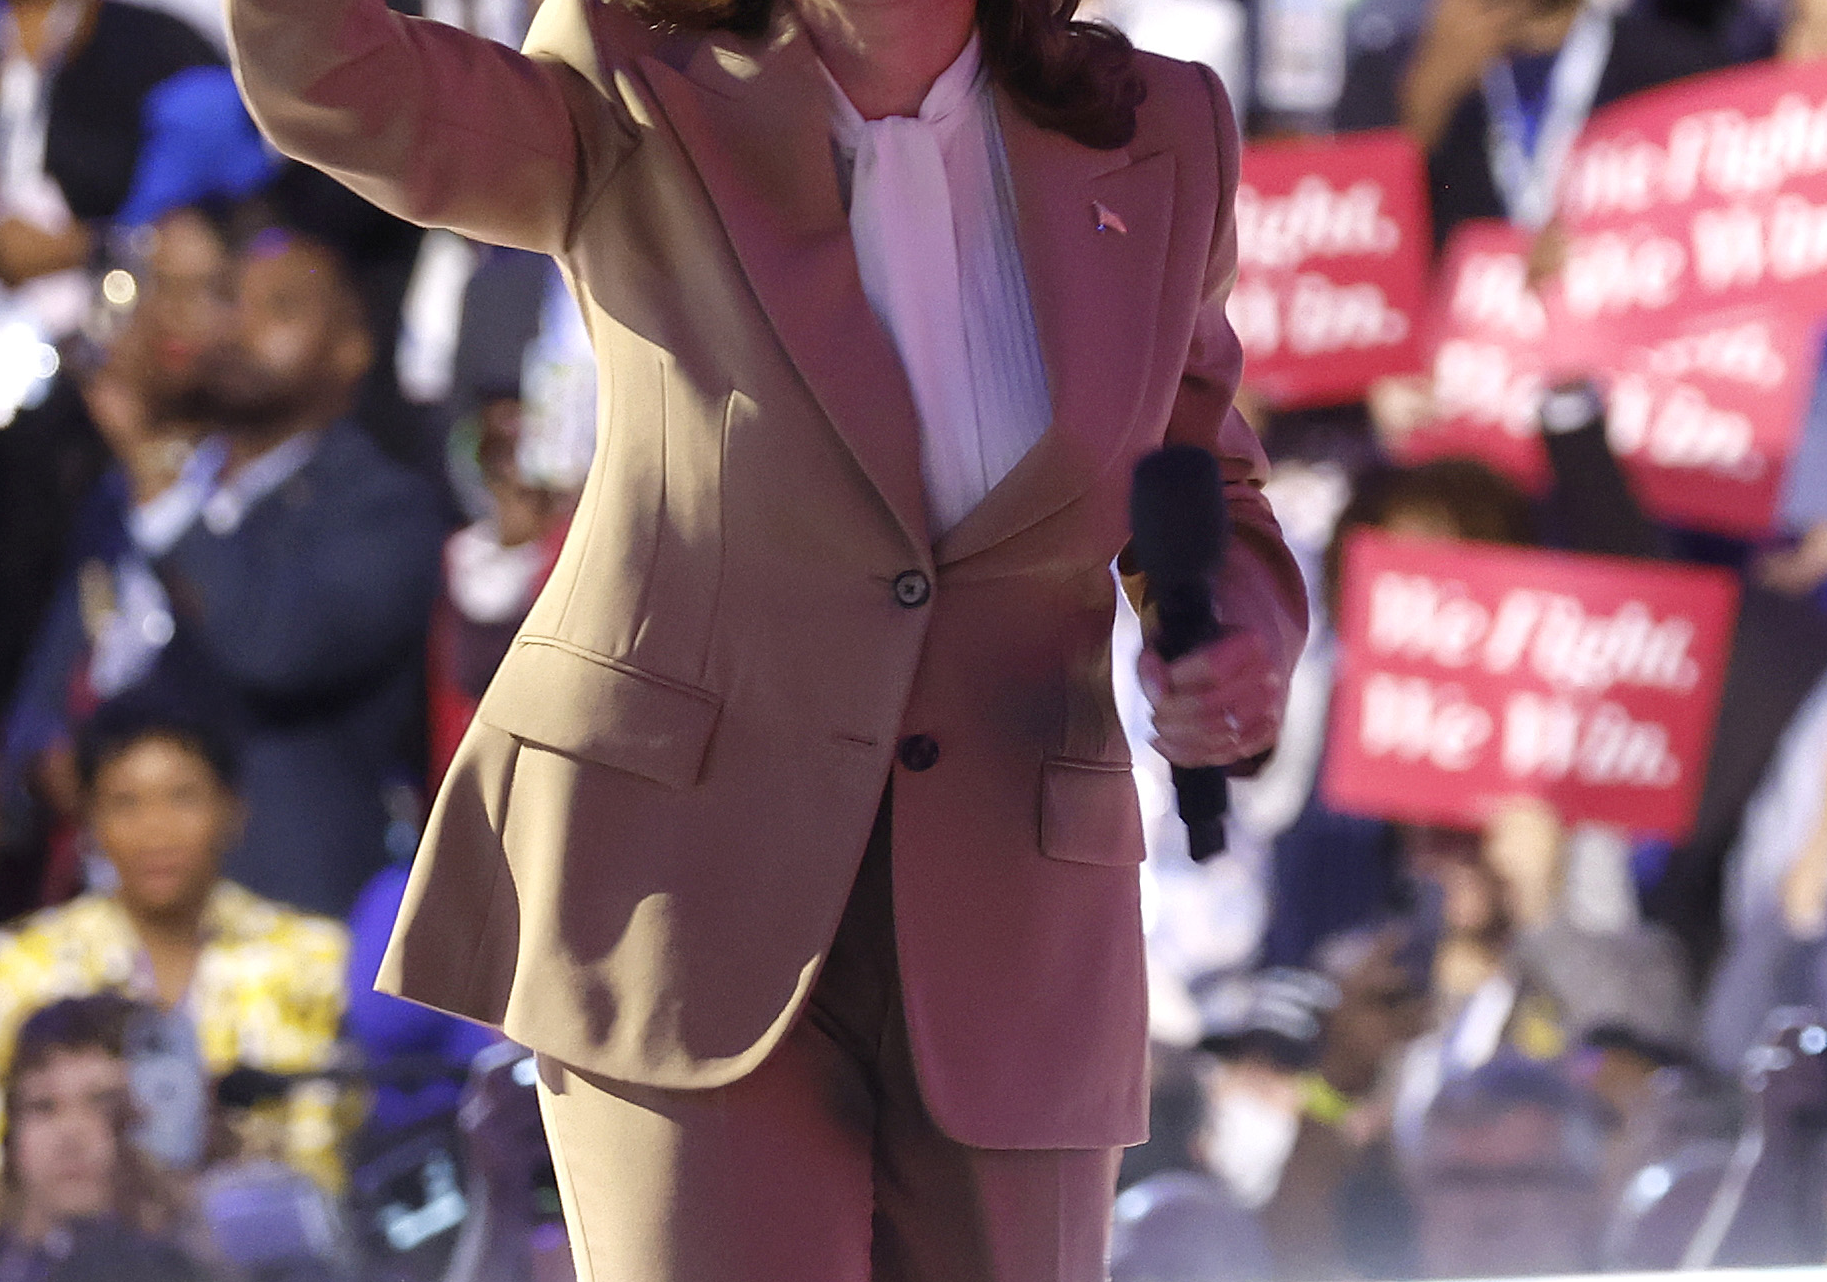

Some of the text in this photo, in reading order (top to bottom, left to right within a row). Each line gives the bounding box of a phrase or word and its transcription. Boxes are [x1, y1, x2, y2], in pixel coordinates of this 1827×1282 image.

[1562, 222, 1686, 318] We
[1369, 569, 1699, 696] We Fight.
[1362, 667, 1681, 791] We Win.
